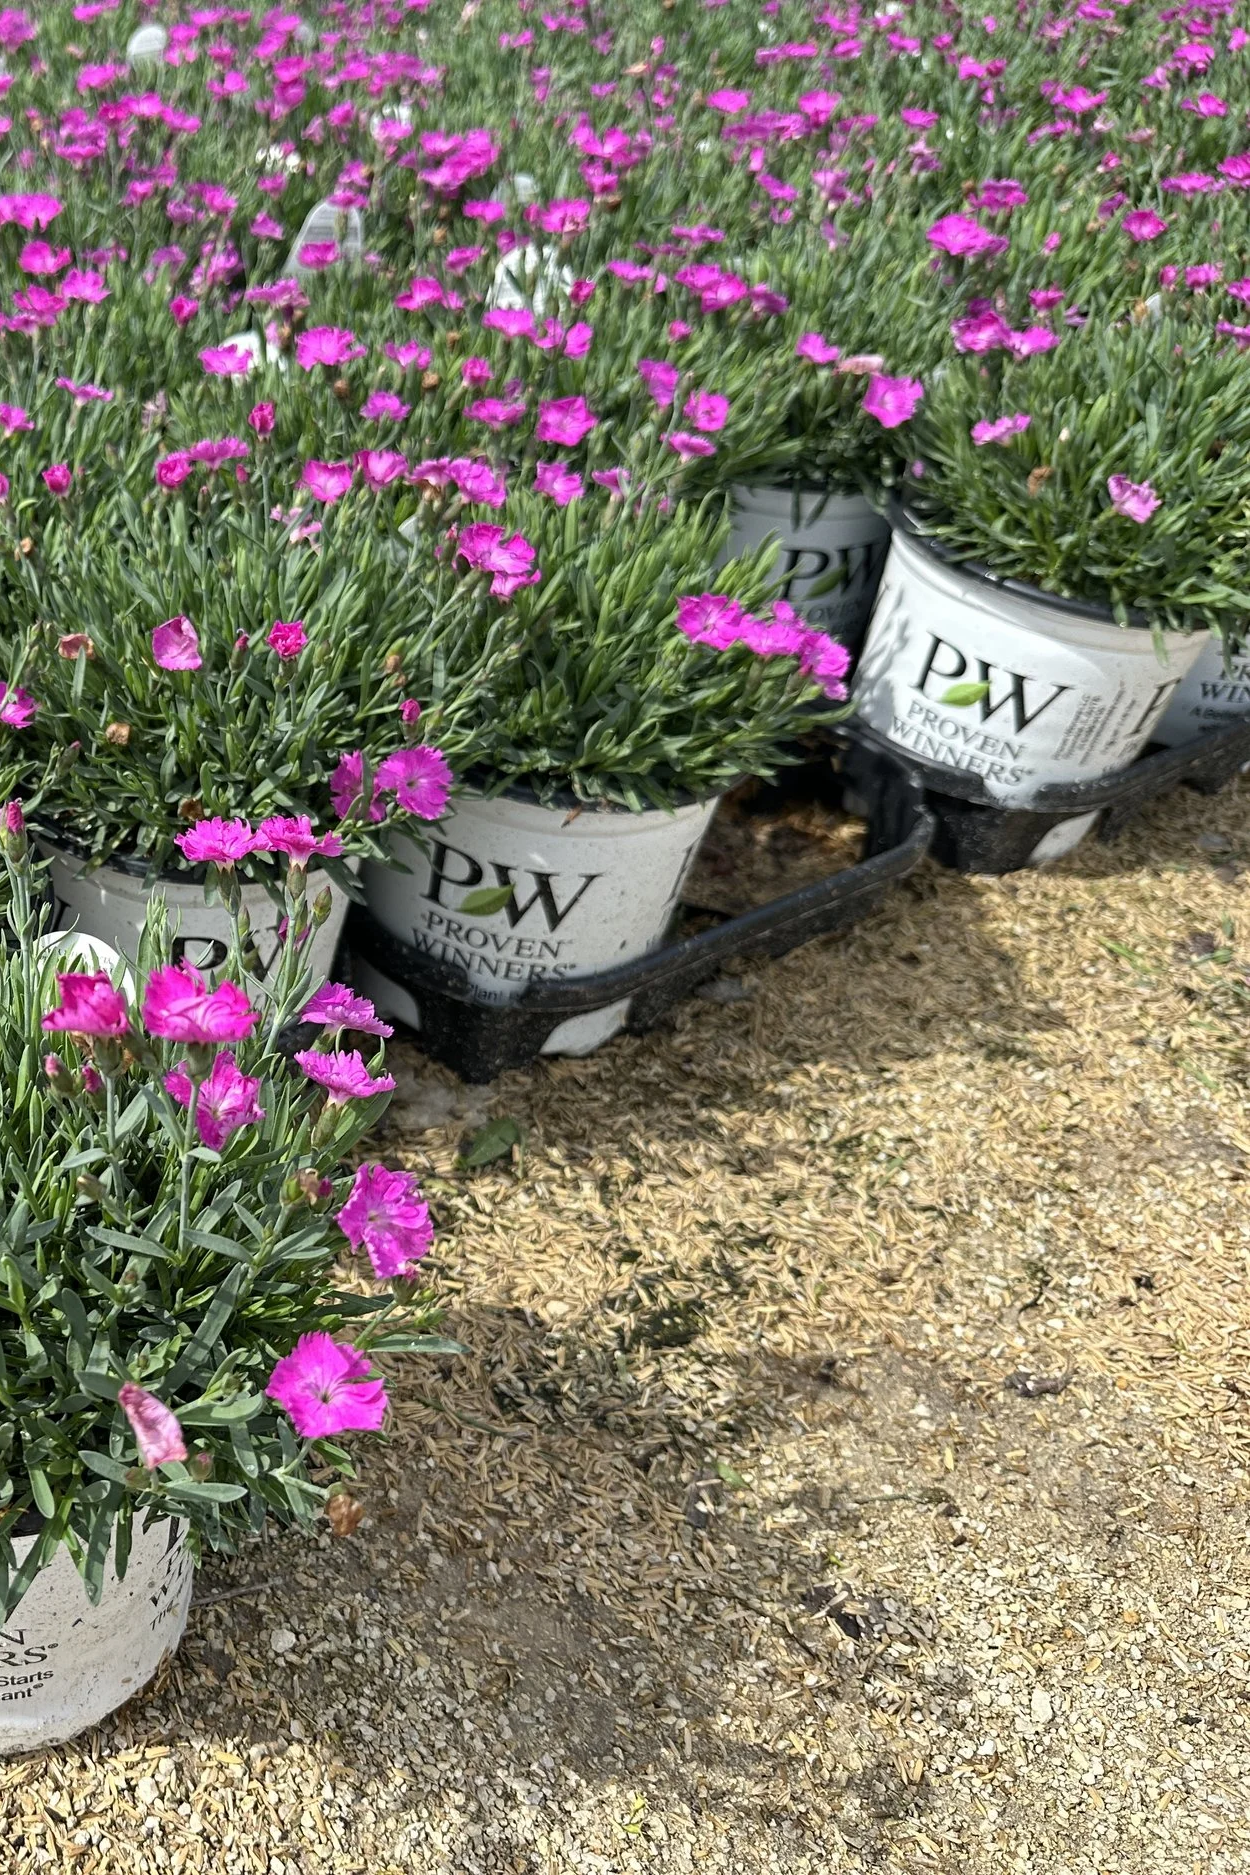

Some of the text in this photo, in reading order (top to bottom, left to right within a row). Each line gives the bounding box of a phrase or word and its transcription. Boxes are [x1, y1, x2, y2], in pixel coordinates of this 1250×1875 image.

[907, 629, 1075, 734] PW
[906, 699, 1026, 761] PROVEN
[419, 834, 604, 932] PW
[425, 909, 565, 960] PROVEN
